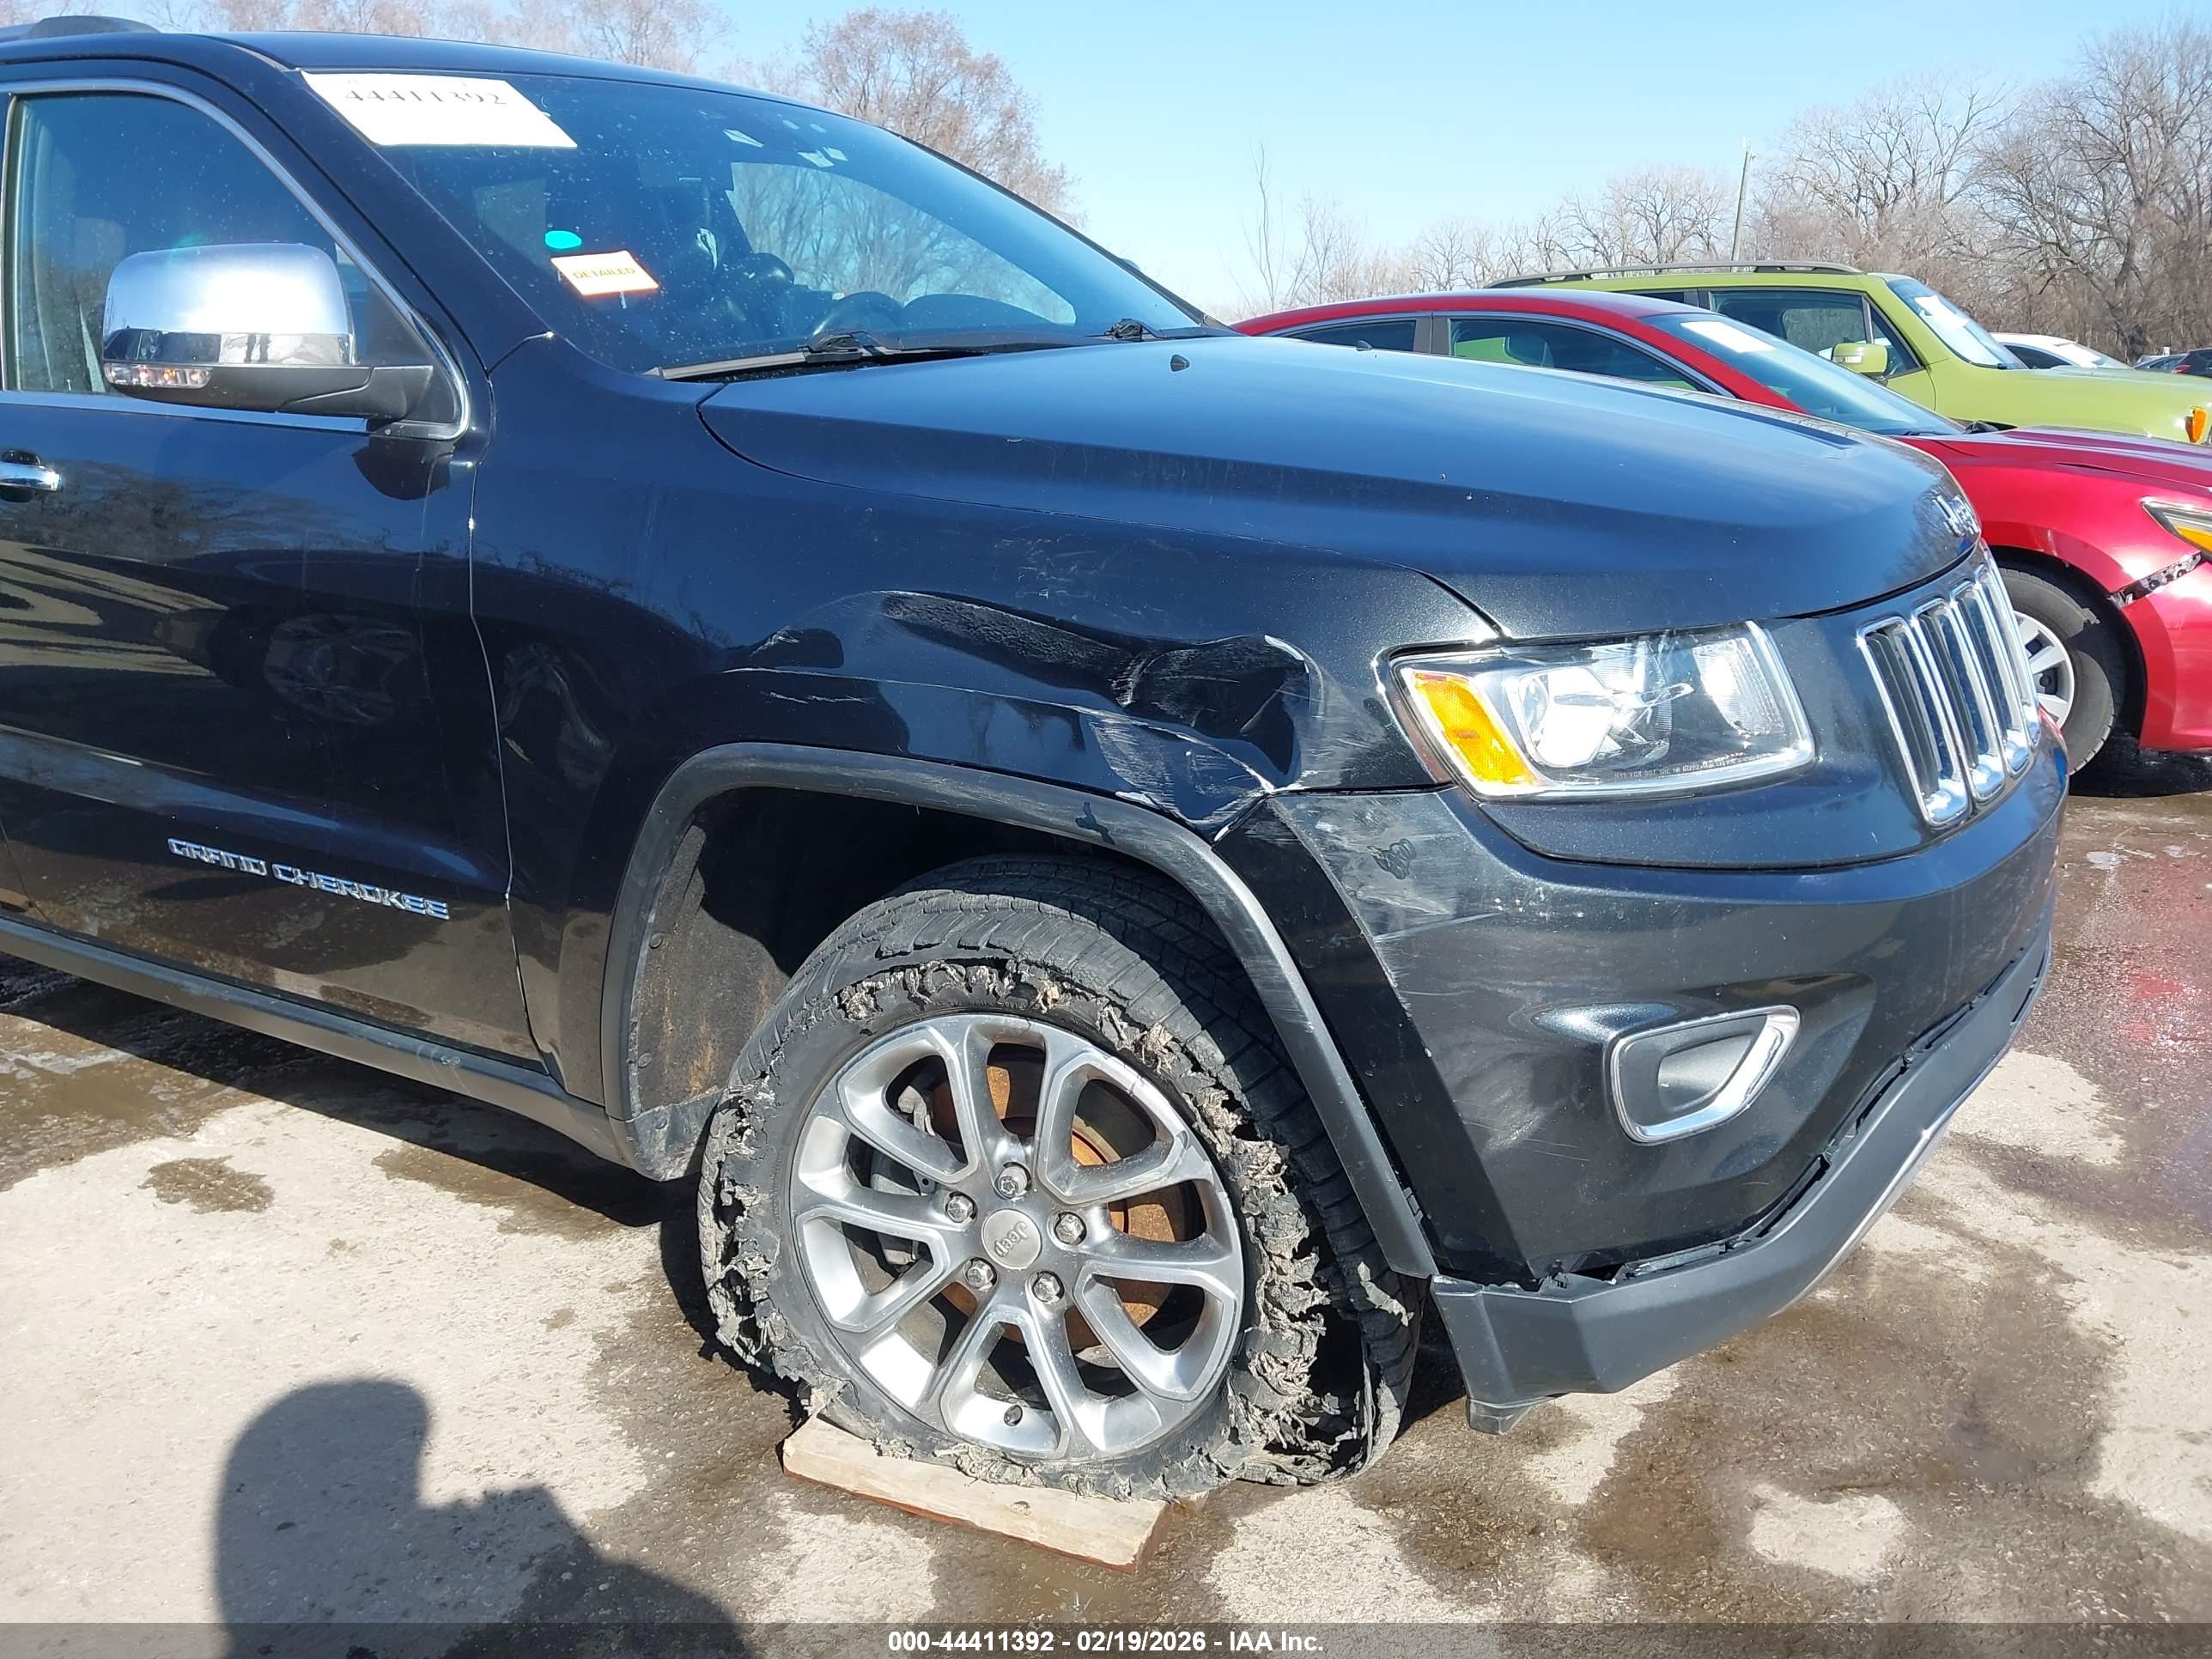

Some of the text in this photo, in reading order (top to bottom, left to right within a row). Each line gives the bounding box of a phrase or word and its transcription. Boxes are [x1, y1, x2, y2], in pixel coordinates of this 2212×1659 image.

[573, 267, 636, 280] DETAILED
[167, 837, 451, 921] GRAND CHEROKEE
[994, 1220, 1029, 1258] Jeep
